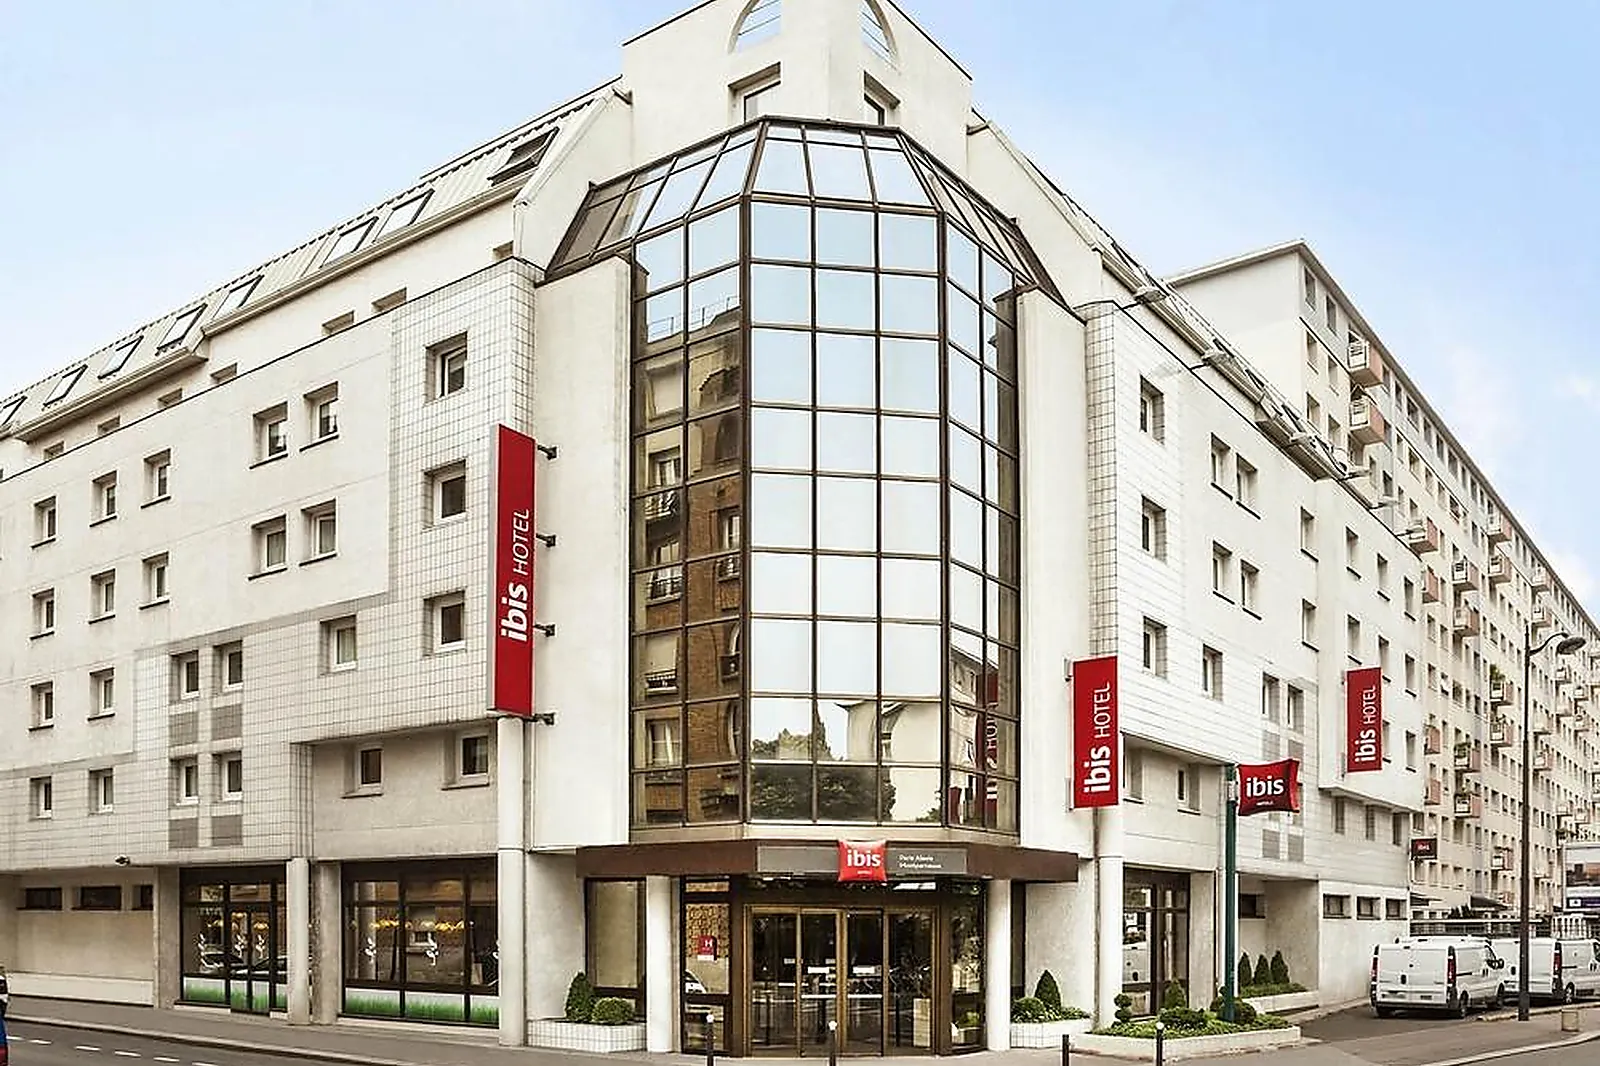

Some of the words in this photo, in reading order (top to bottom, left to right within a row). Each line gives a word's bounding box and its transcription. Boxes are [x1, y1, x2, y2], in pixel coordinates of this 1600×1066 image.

[512, 508, 530, 576] HOTEL
[501, 582, 528, 642] ibis
[1093, 681, 1111, 739] HOTEL
[1362, 685, 1377, 725] HOTEL
[1354, 728, 1376, 762] ibis
[1083, 745, 1111, 793] ibis
[1246, 775, 1285, 798] ibis
[847, 849, 881, 867] ibis
